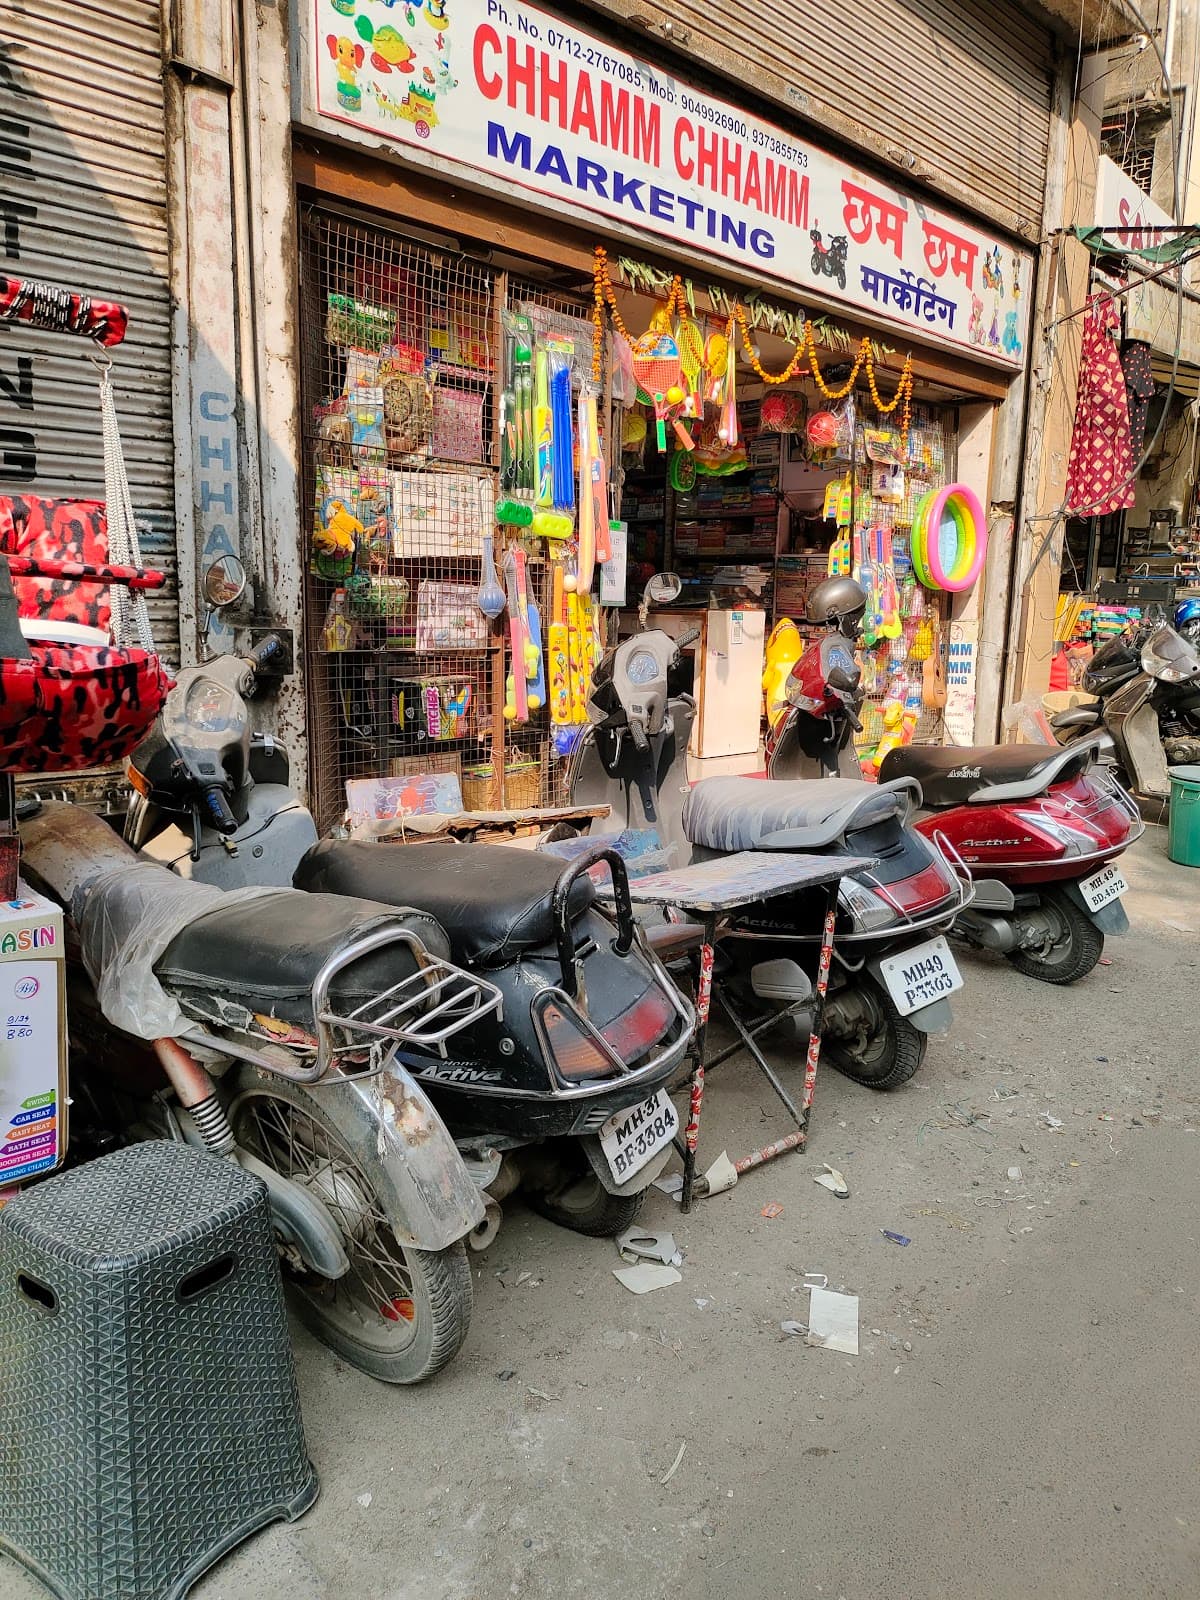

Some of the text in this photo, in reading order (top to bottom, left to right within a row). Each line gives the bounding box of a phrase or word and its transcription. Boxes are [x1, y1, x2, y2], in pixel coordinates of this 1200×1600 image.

[487, 0, 808, 168] Ph. No. 0712-2767085, Mob: 9049926900, 9373855753
[473, 23, 810, 231] CHHAMM CHHAMM
[487, 120, 775, 258] MARKETING
[841, 179, 979, 291] छम छम
[860, 265, 957, 329] मार्केटिंग
[420, 1065, 503, 1081] Activa
[27, 1096, 50, 1107] SWING
[16, 1109, 51, 1124] CAR SEAT
[32, 1122, 52, 1132] SEAT
[8, 1135, 51, 1153] BATH SEAT
[32, 1148, 51, 1158] SEAT
